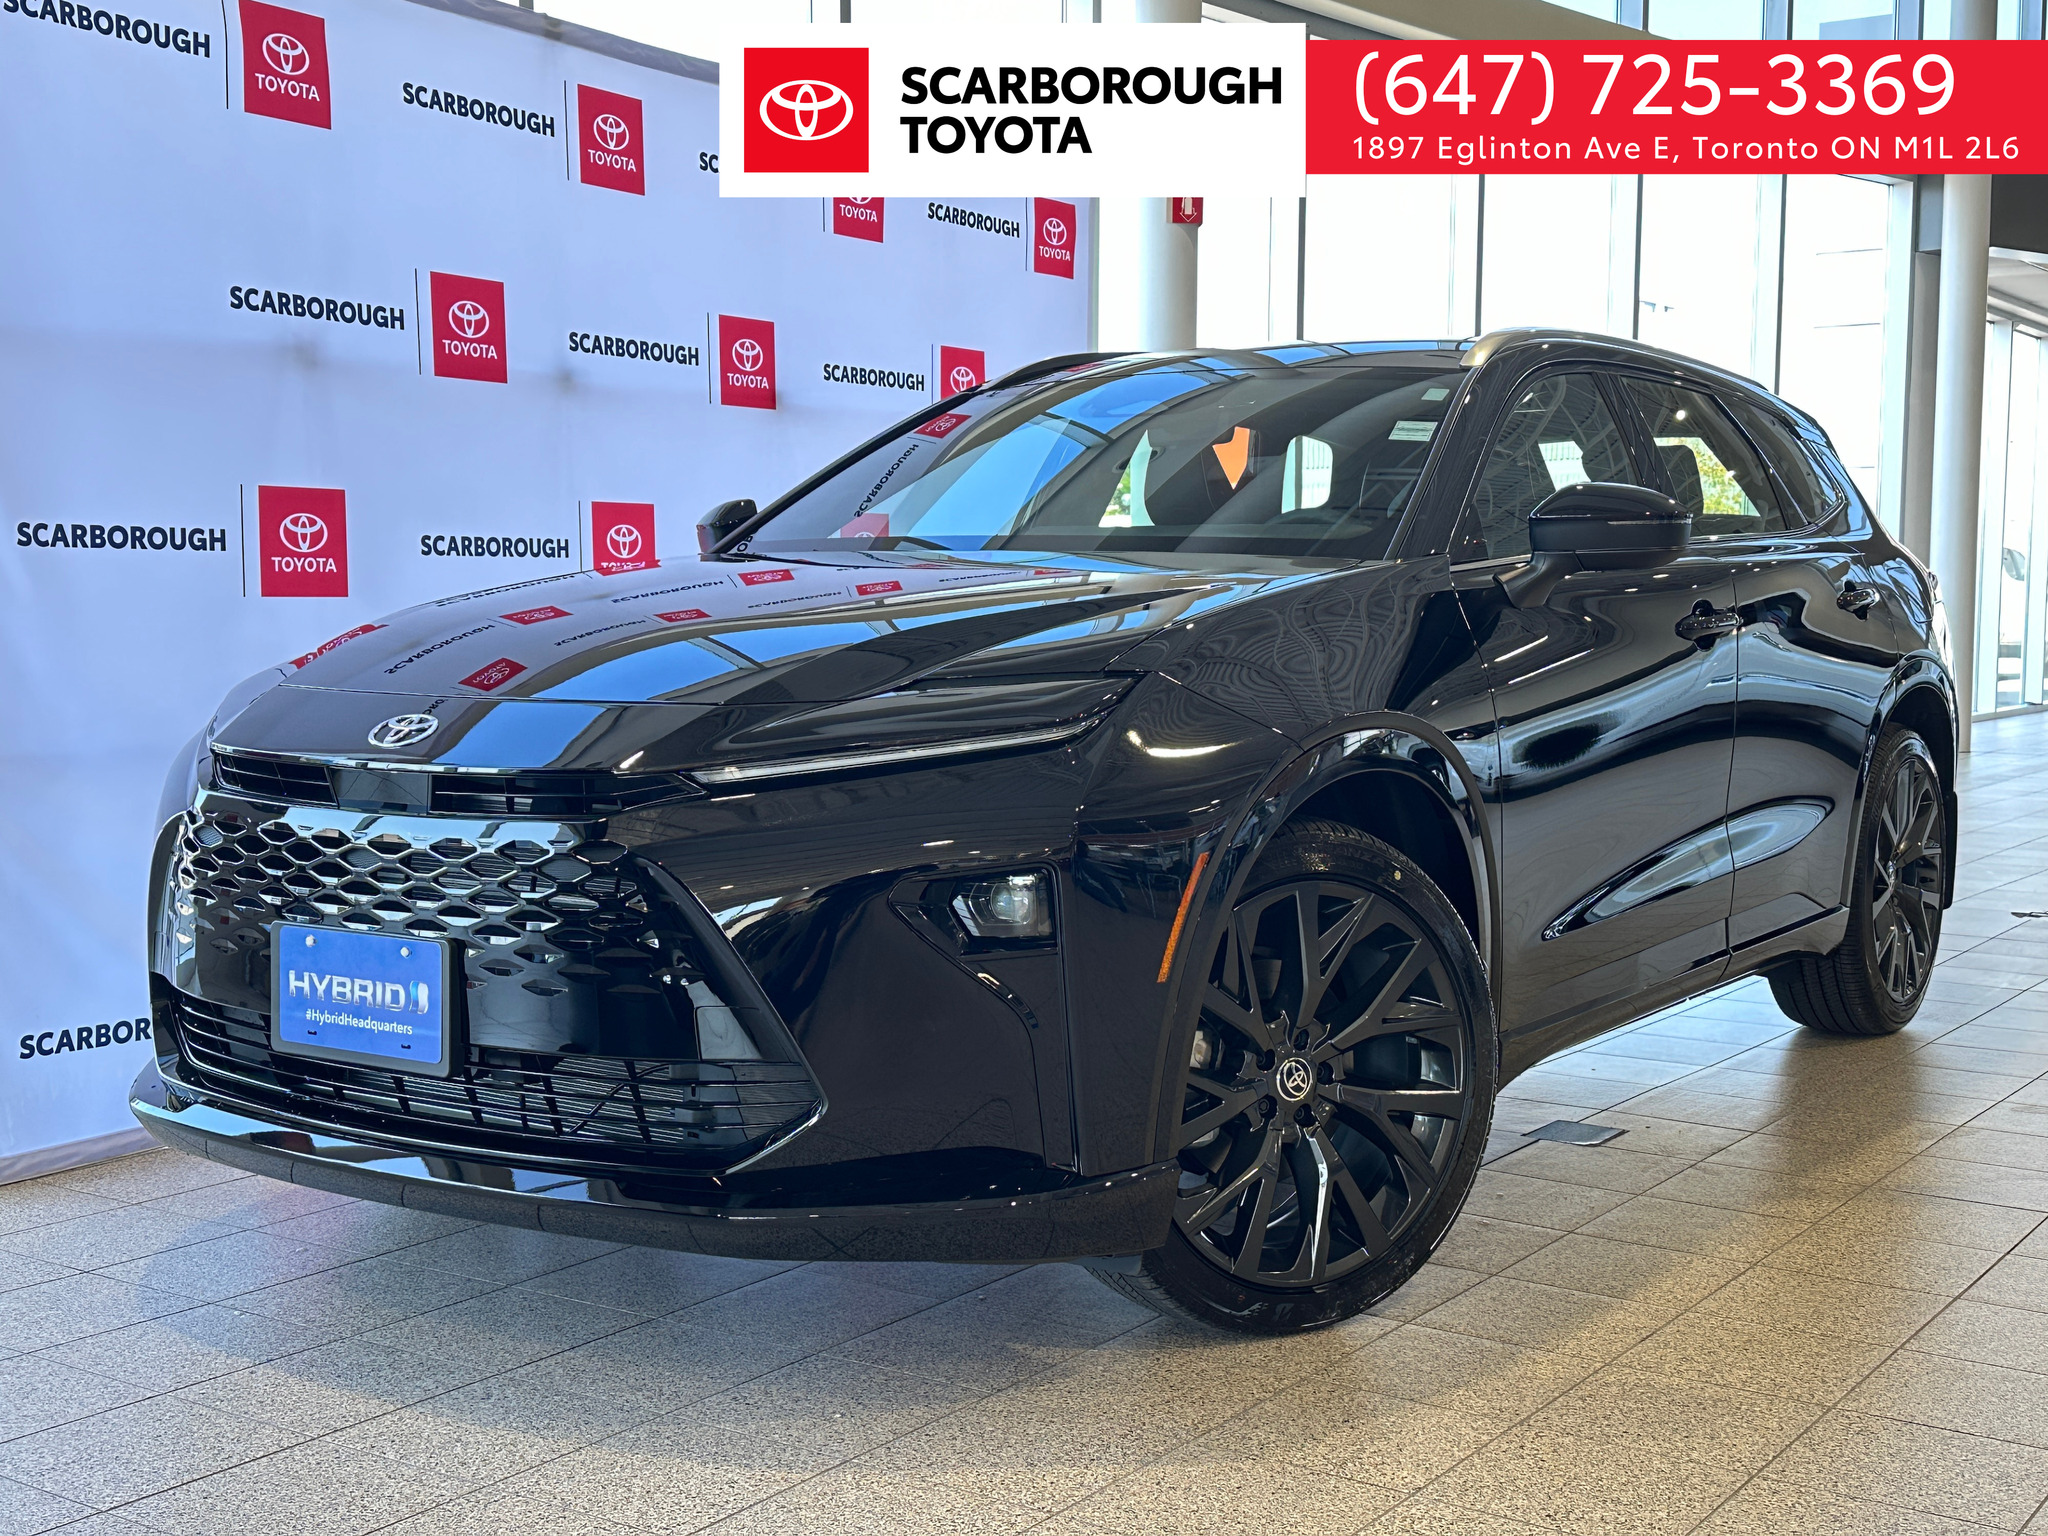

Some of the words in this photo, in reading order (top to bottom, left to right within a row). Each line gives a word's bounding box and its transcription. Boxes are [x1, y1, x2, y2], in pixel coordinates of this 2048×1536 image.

[4, 0, 210, 58] SCARBOROUGH
[255, 73, 320, 102] TOYOTA
[403, 83, 555, 137] SCARBOROUGH
[588, 149, 637, 172] TOYOTA
[839, 204, 878, 223] TOYOTA
[928, 203, 1020, 238] SCARBOROUGH
[1039, 245, 1071, 262] TOYOTA
[230, 286, 404, 330] SCARBOROUGH
[442, 340, 498, 360] TOYOTA
[569, 332, 699, 366] SCARBOROUGH
[727, 372, 769, 390] TOYOTA
[823, 363, 925, 392] SCARBOROUGH
[17, 522, 226, 551] SCARBOROUGH
[421, 535, 569, 559] SCARBOROUGH
[271, 557, 337, 573] TOYOTA
[289, 970, 406, 1012] HYBRID
[306, 1008, 413, 1035] #HybridHeadquarters
